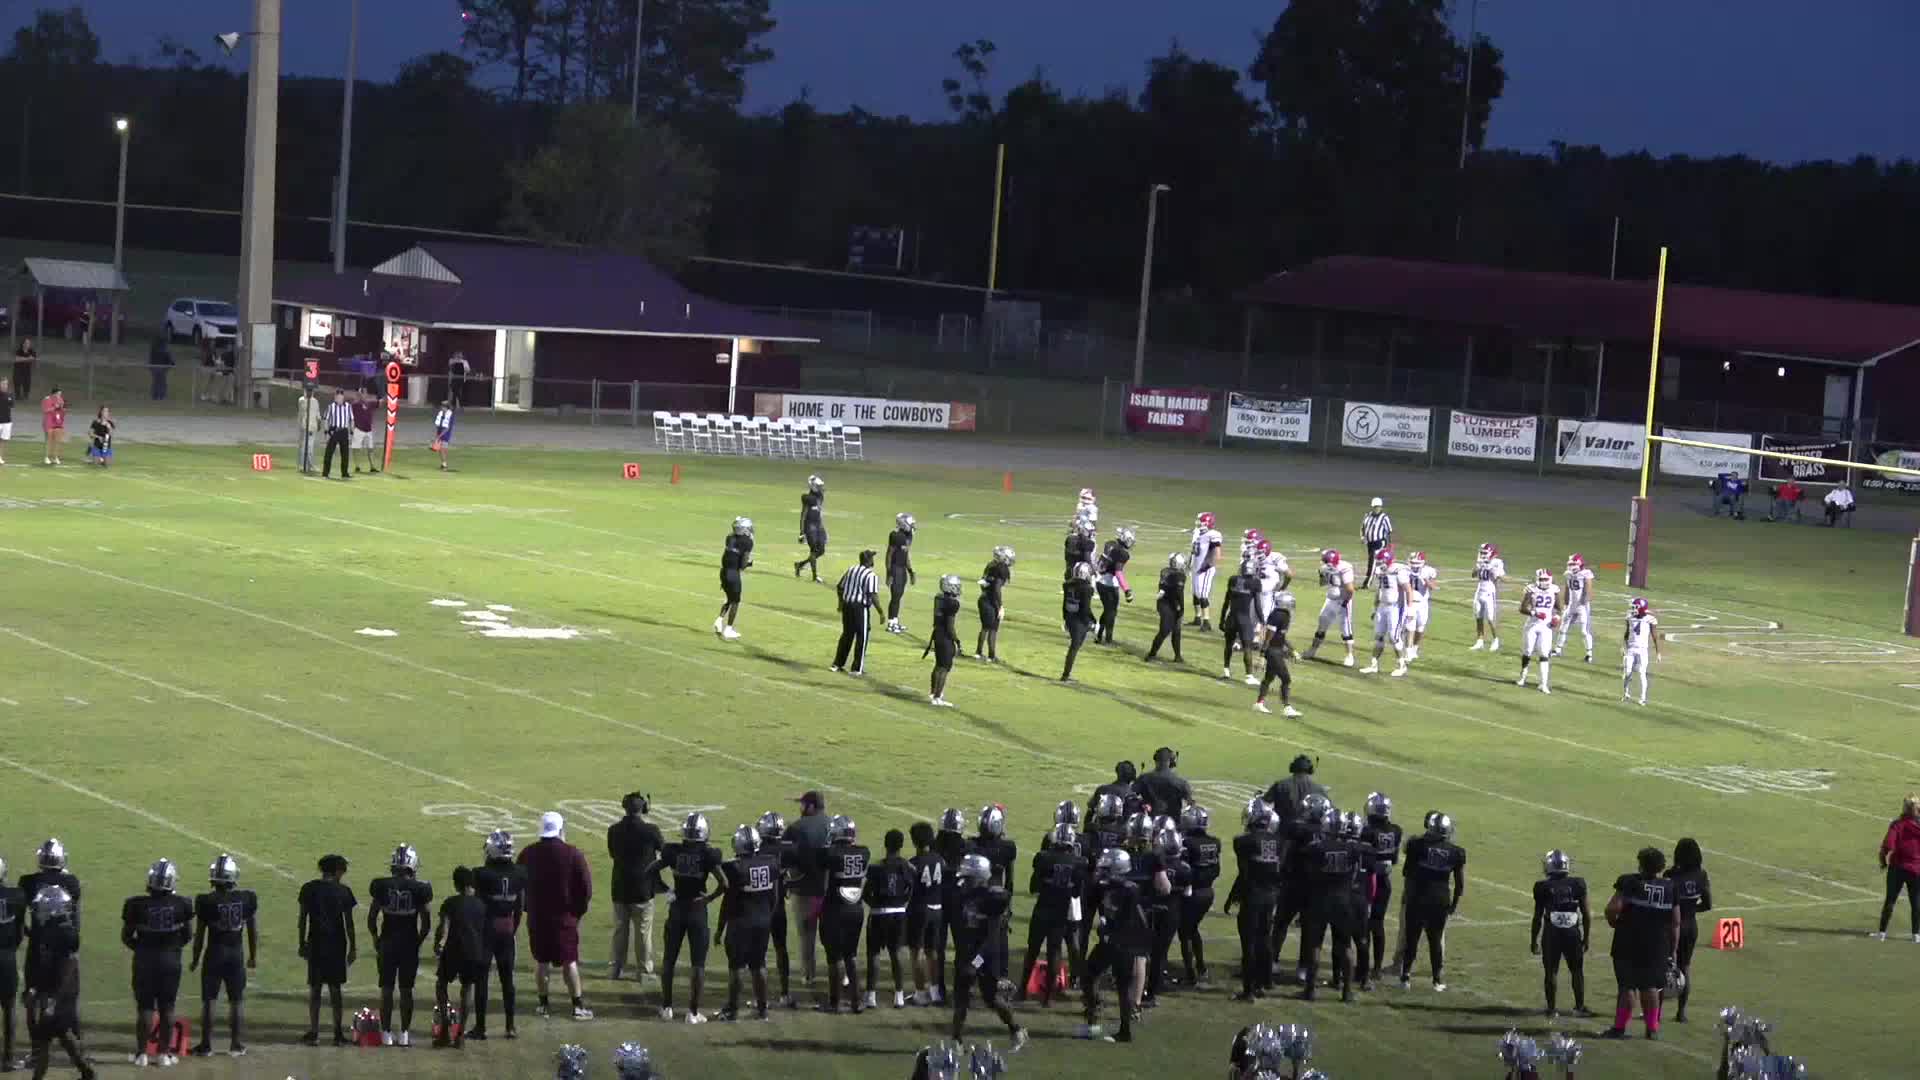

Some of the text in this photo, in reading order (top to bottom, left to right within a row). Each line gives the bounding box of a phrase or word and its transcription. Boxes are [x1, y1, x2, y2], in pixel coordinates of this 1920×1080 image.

[305, 361, 318, 379] 3
[789, 400, 824, 418] HOME
[831, 403, 846, 418] OF
[854, 404, 876, 420] THE
[883, 405, 943, 423] COWBOYS
[1147, 411, 1185, 426] FARMS
[1237, 425, 1251, 434] GO
[1465, 426, 1520, 439] LUMBER
[1452, 440, 1532, 456] (850) 973-6106
[1585, 435, 1635, 451] Valor
[255, 455, 268, 470] 10
[627, 464, 637, 478] G
[1536, 595, 1552, 609] 22
[1633, 622, 1642, 635] 4
[845, 855, 864, 878] 55
[921, 863, 943, 887] 44
[1721, 920, 1741, 948] 20
